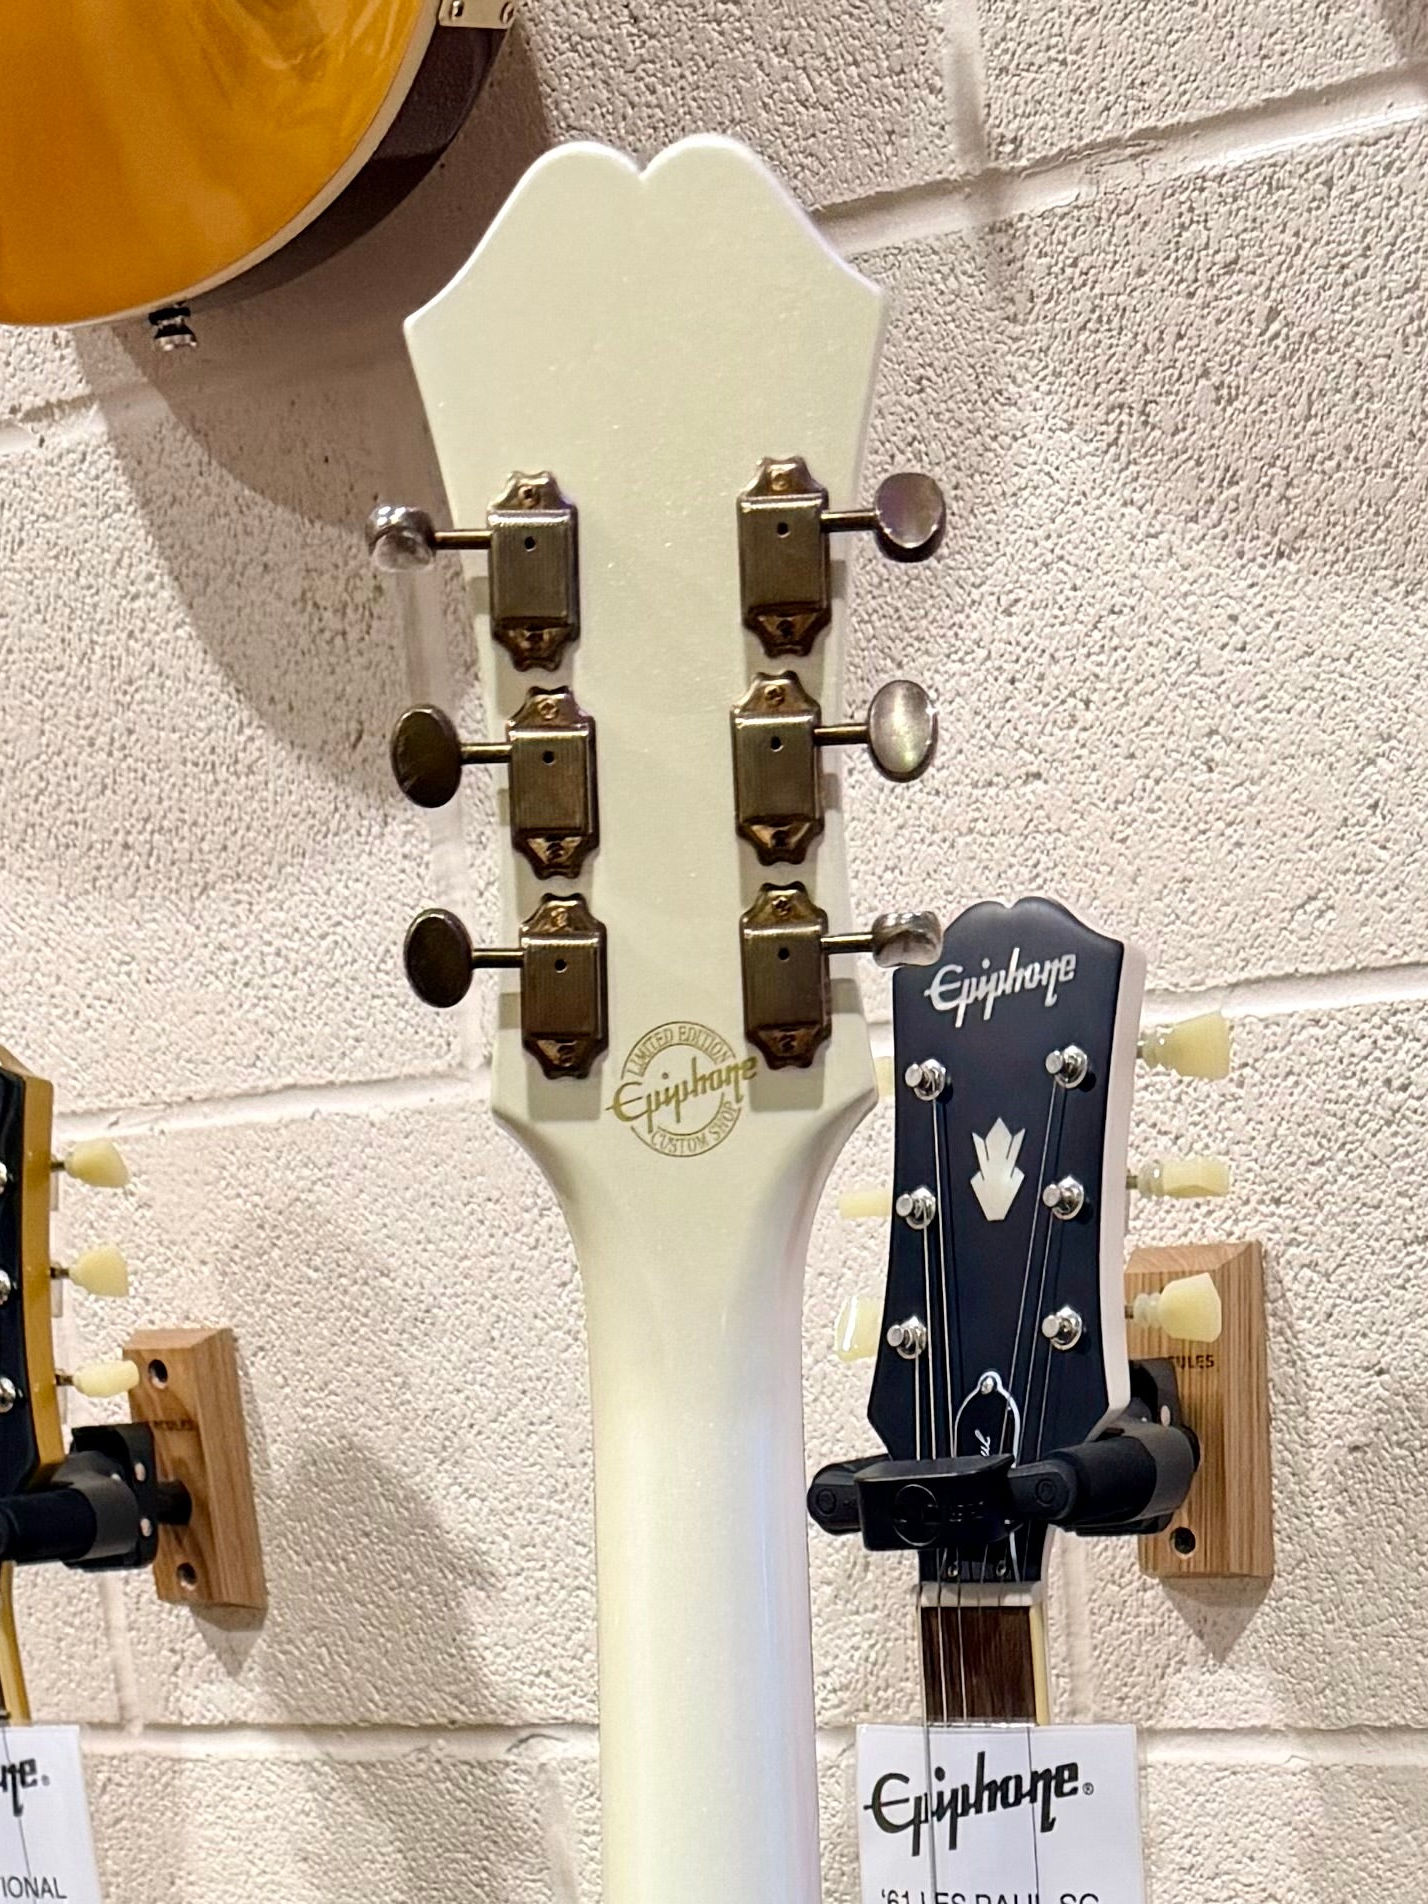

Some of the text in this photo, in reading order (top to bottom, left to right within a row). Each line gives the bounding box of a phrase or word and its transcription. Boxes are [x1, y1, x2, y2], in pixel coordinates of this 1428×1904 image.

[923, 947, 1076, 1028] Epiphone
[627, 1025, 732, 1077] LIMITED EDITION
[605, 1056, 758, 1134] Epiphone
[650, 1101, 740, 1154] CUSTOM SHOP
[863, 1750, 1080, 1857] Epiphone
